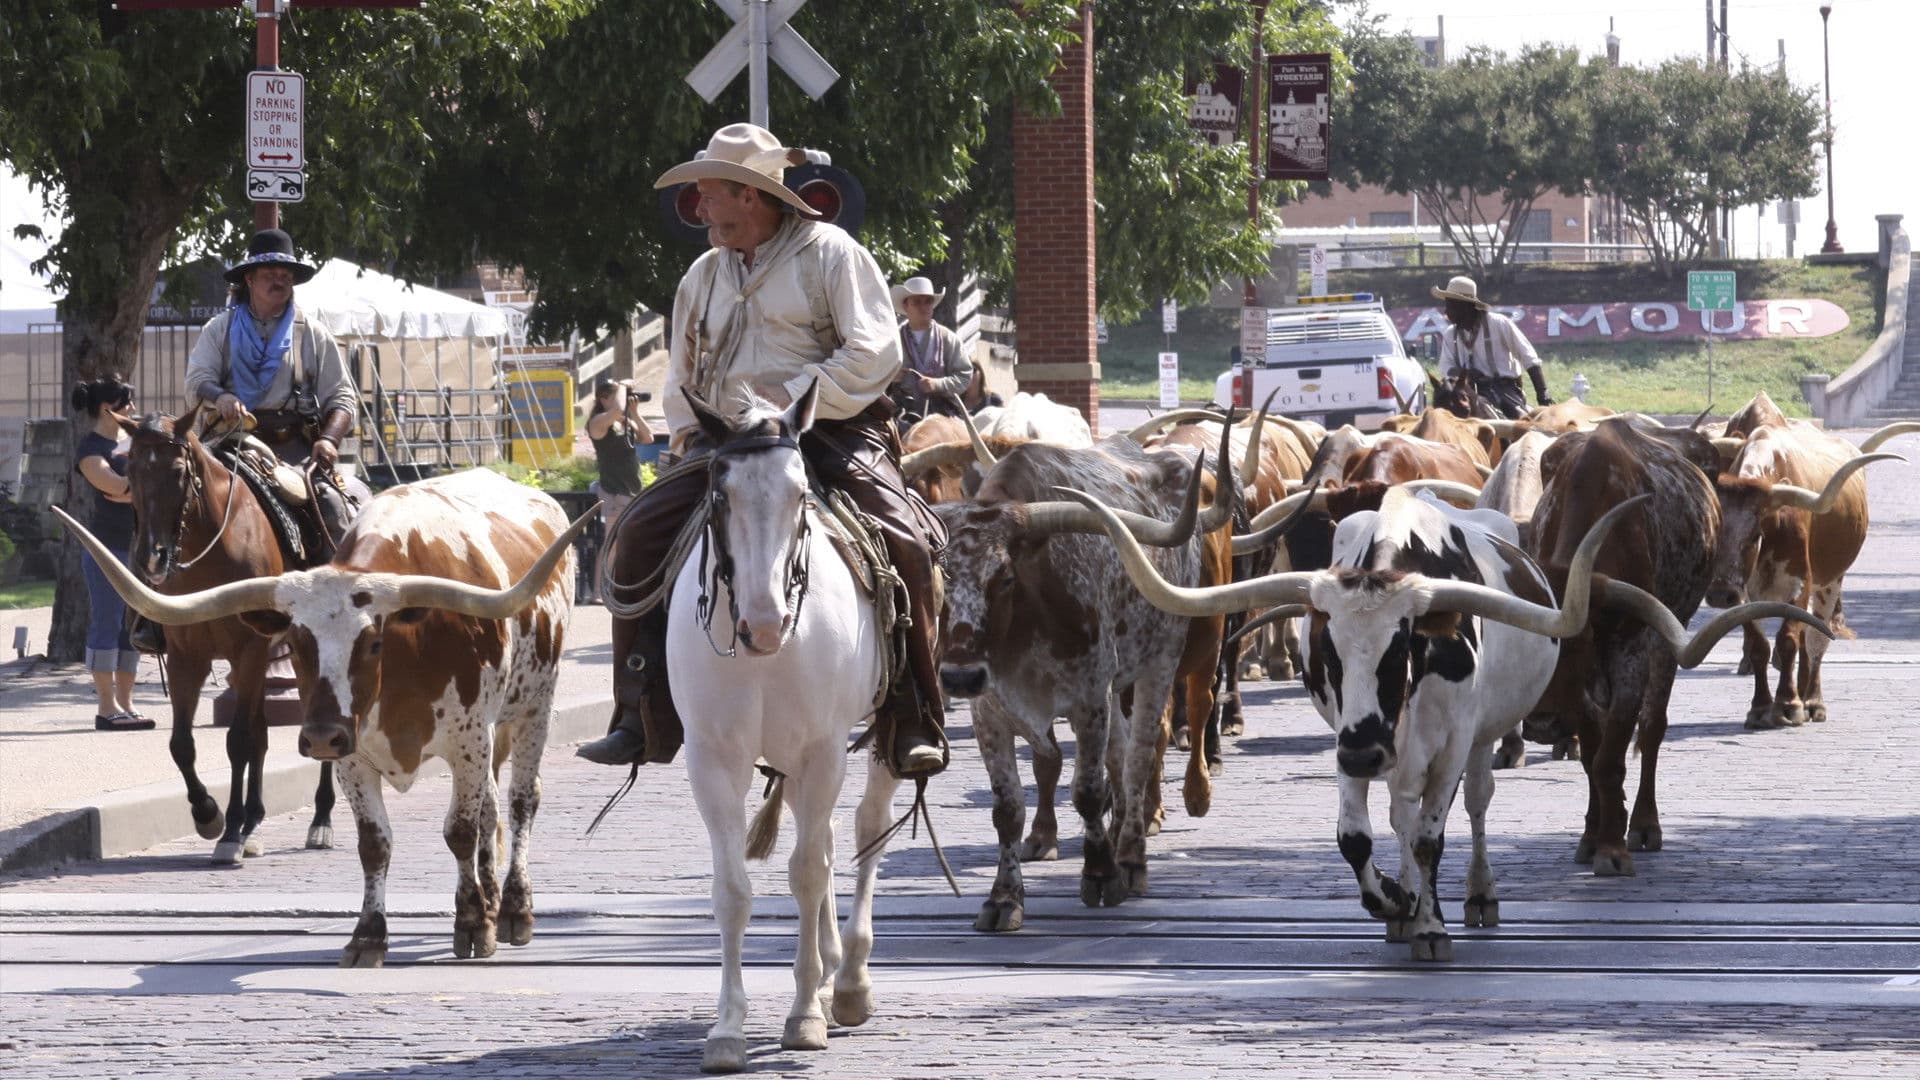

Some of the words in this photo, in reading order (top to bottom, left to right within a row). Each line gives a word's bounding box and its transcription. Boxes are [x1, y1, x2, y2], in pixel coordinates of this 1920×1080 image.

[1274, 73, 1324, 81] STOCKYARDS
[266, 80, 286, 95] NO
[256, 97, 295, 109] PARKING
[253, 111, 297, 122] STOPPING
[269, 124, 281, 135] OR
[253, 137, 298, 149] STANDING
[1403, 302, 1814, 341] AMOUR
[1354, 363, 1372, 374] 218
[1278, 391, 1357, 405] OLICE
